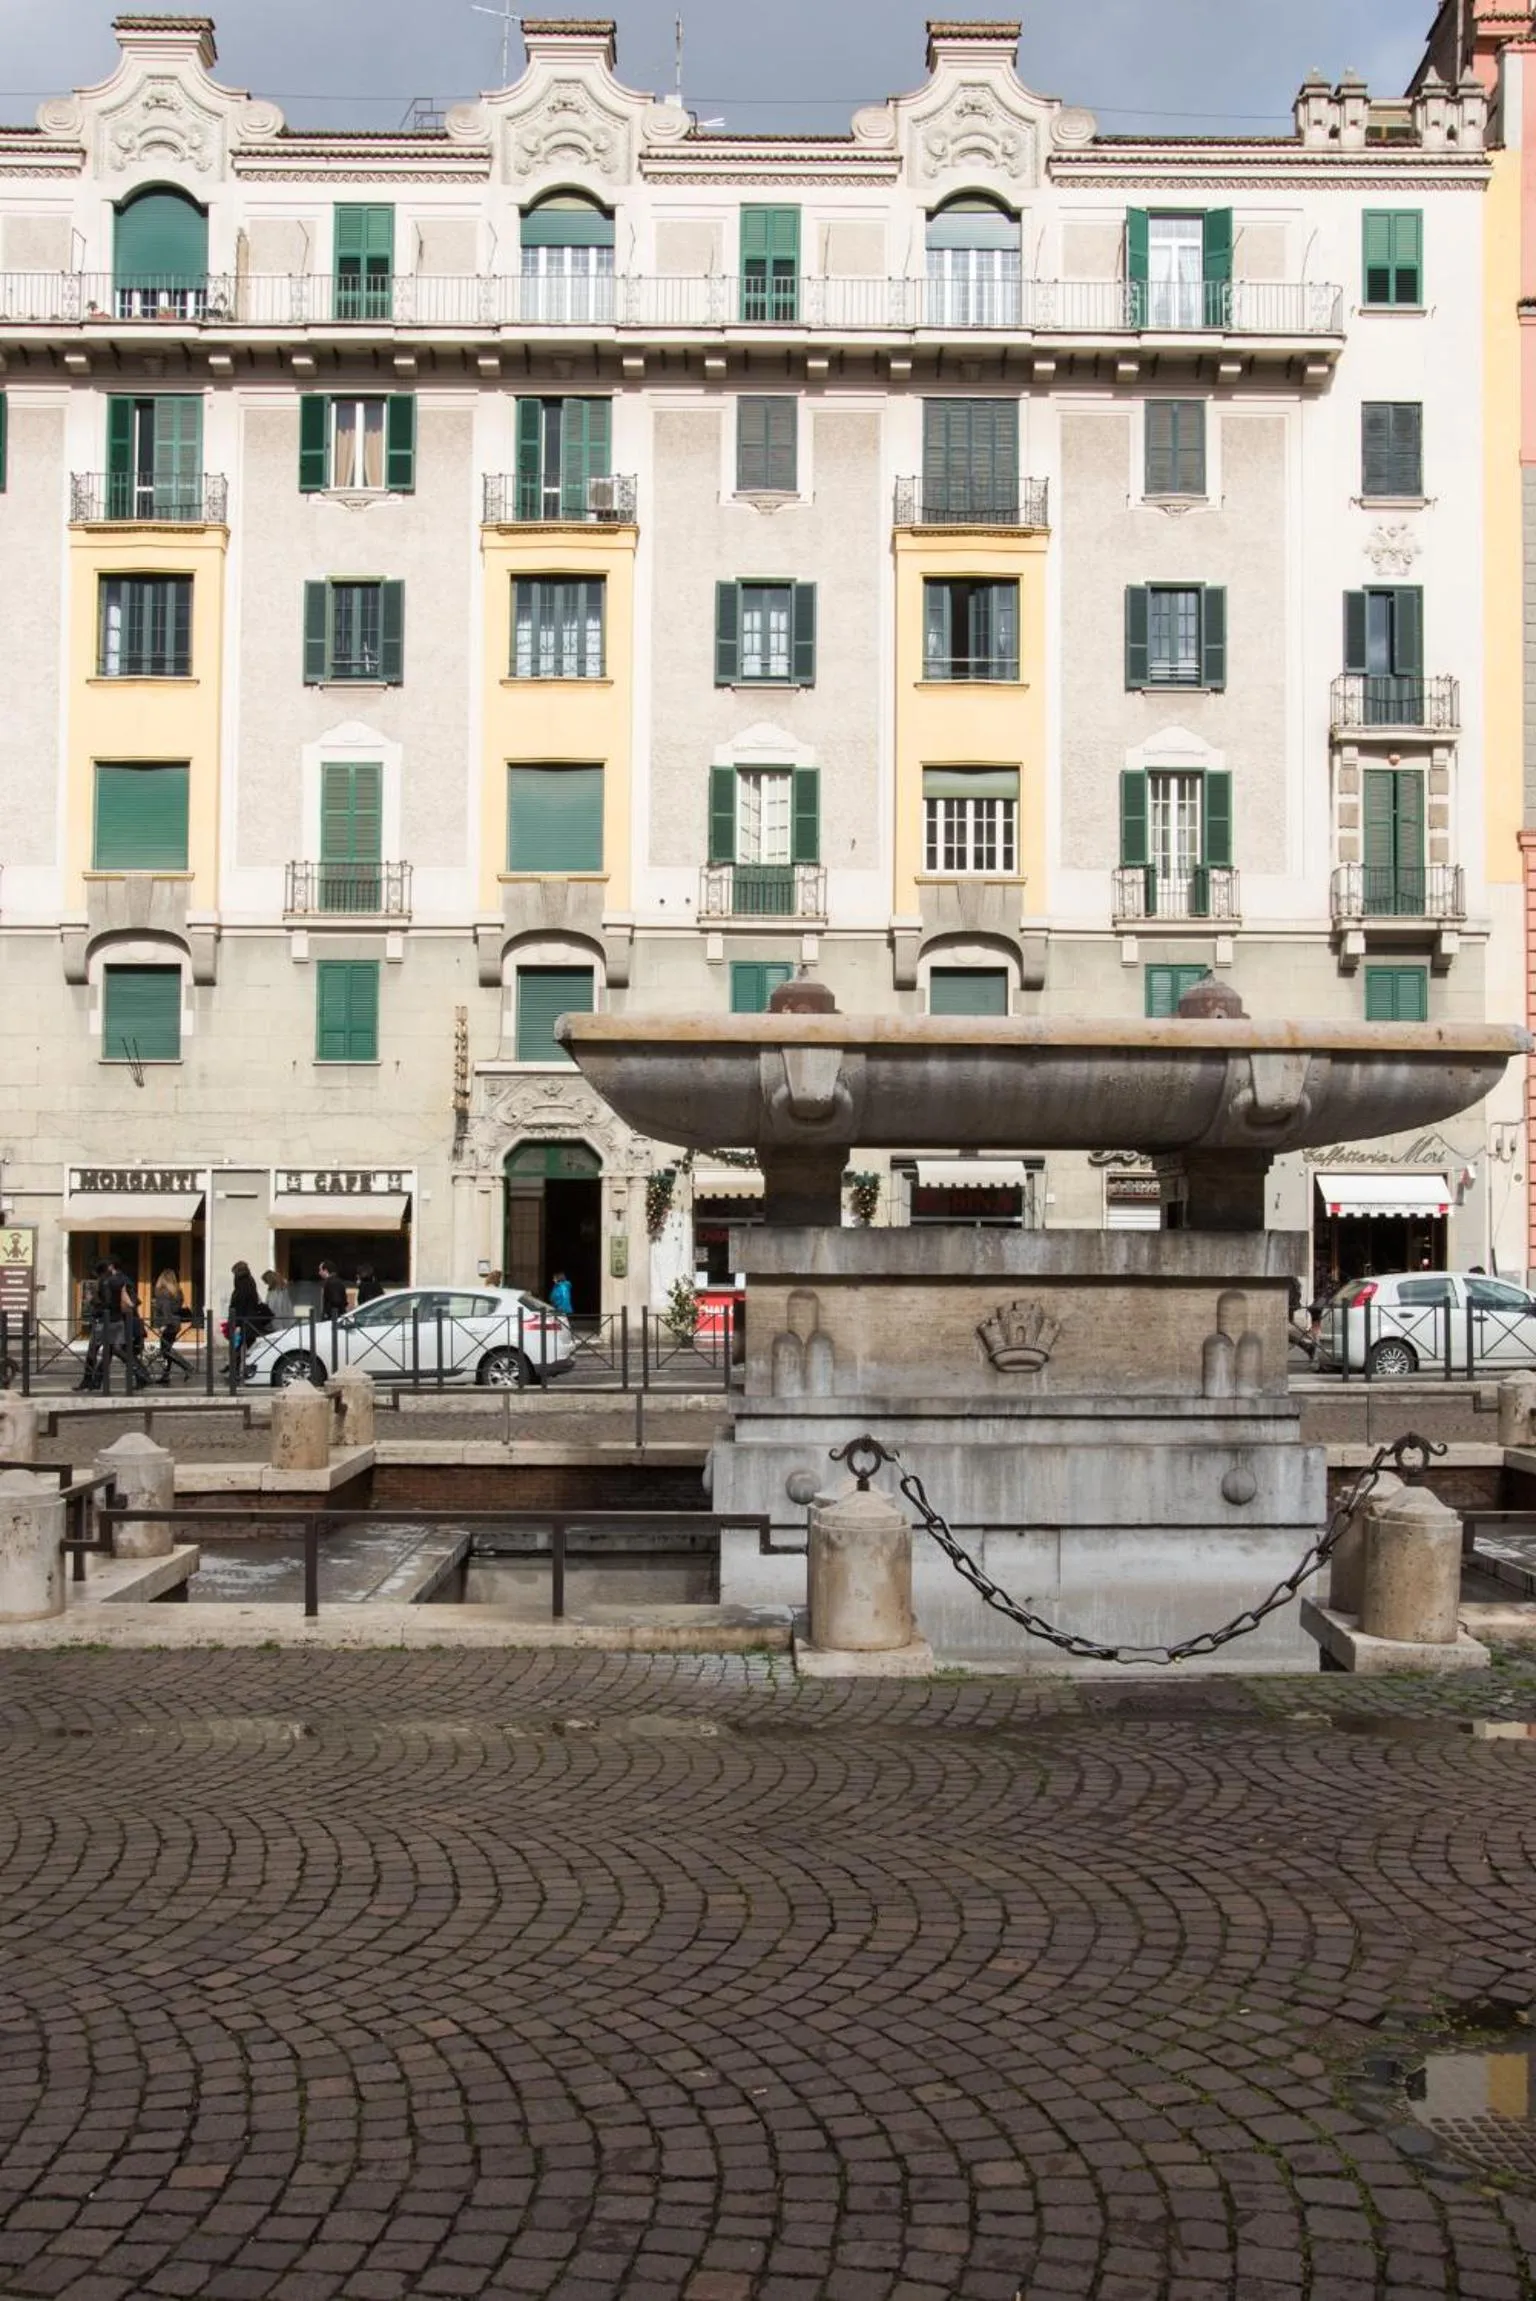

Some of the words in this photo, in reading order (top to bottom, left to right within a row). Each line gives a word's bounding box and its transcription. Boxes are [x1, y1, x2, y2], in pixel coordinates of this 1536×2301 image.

[1302, 1145, 1391, 1166] Caffetteria
[1391, 1134, 1447, 1164] Mori
[79, 1170, 198, 1190] MORGANTI
